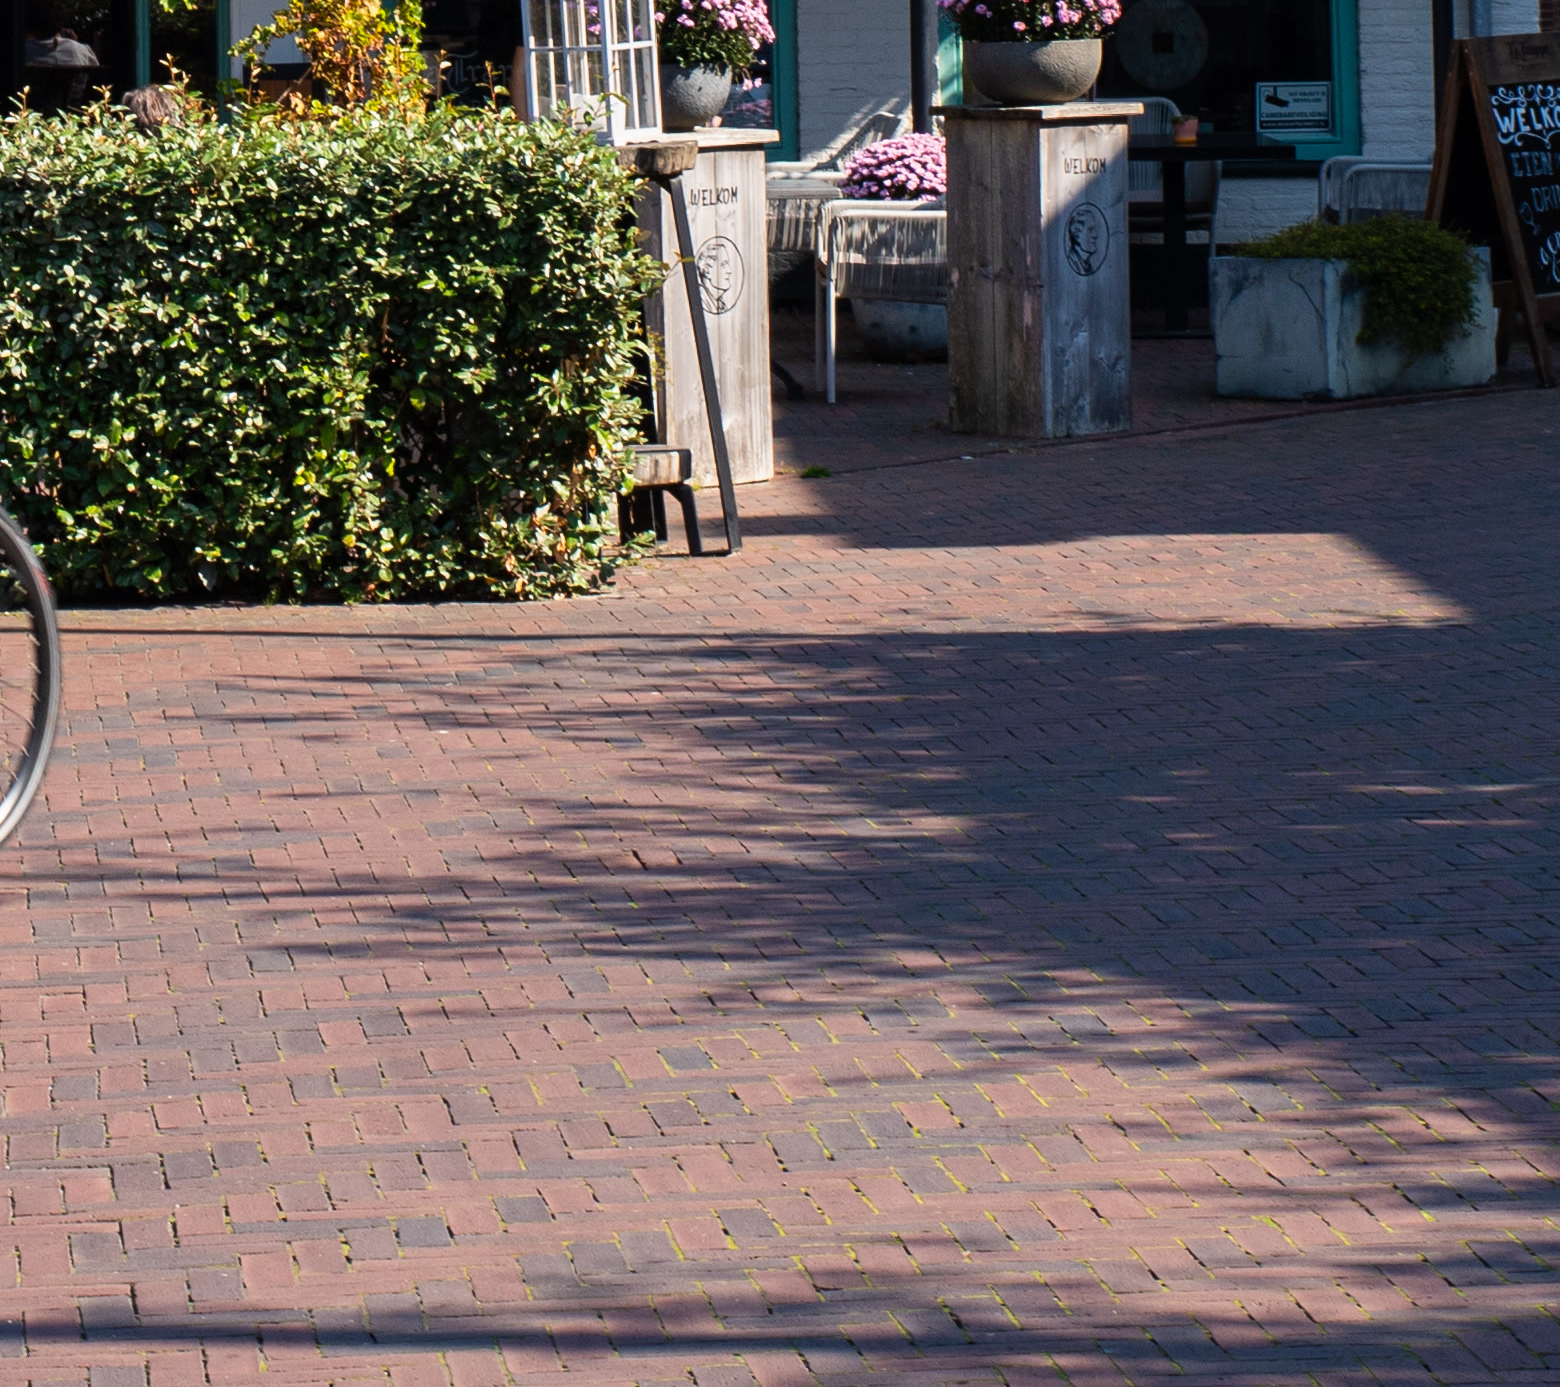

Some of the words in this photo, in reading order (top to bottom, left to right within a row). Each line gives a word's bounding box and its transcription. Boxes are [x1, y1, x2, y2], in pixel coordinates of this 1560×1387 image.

[1064, 157, 1106, 174] WELKOM
[1509, 151, 1554, 177] ETEN
[690, 185, 738, 206] WELKOM
